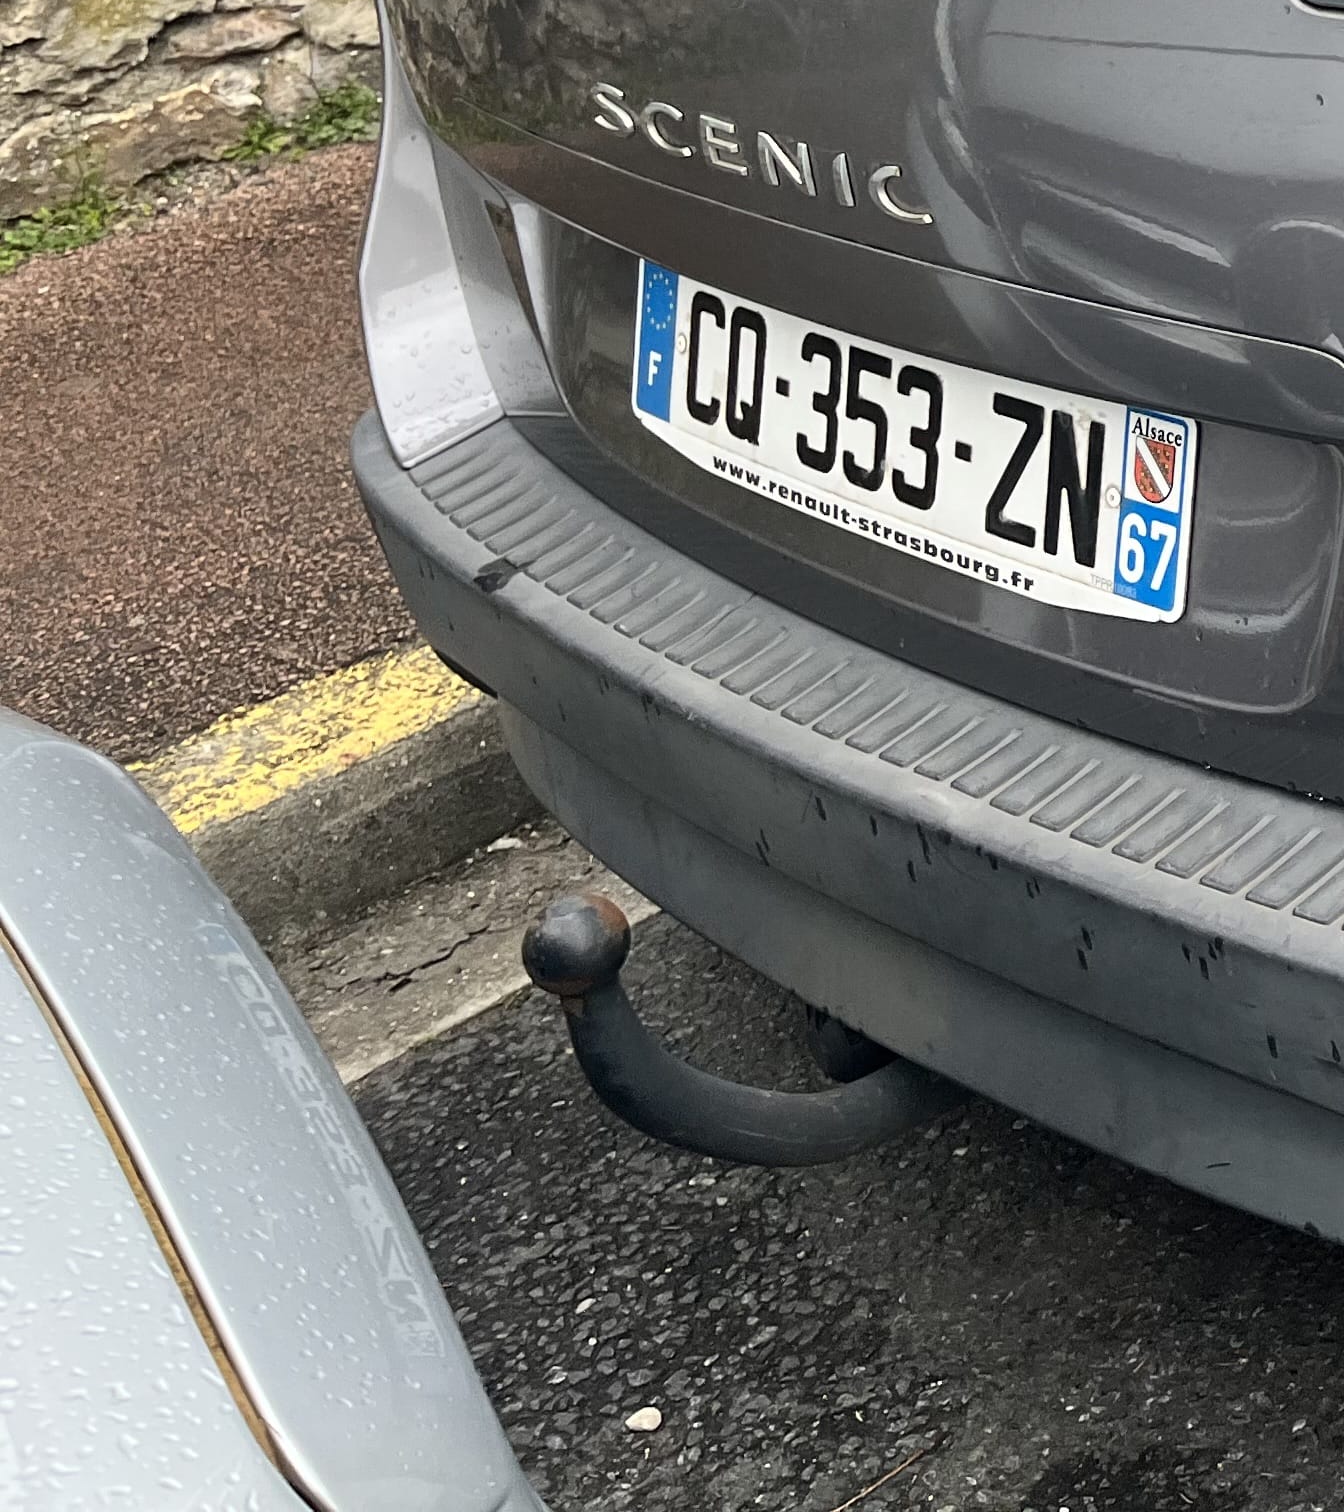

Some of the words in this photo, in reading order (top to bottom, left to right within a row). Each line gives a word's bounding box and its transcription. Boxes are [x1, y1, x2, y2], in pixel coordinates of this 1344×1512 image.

[593, 82, 934, 226] SCENIC
[647, 350, 662, 387] F
[686, 290, 1106, 569] CQ-353-ZN
[1131, 416, 1183, 448] Alsace
[712, 454, 1036, 593] www.renault-strasbourg.fr
[1118, 511, 1177, 592] 67
